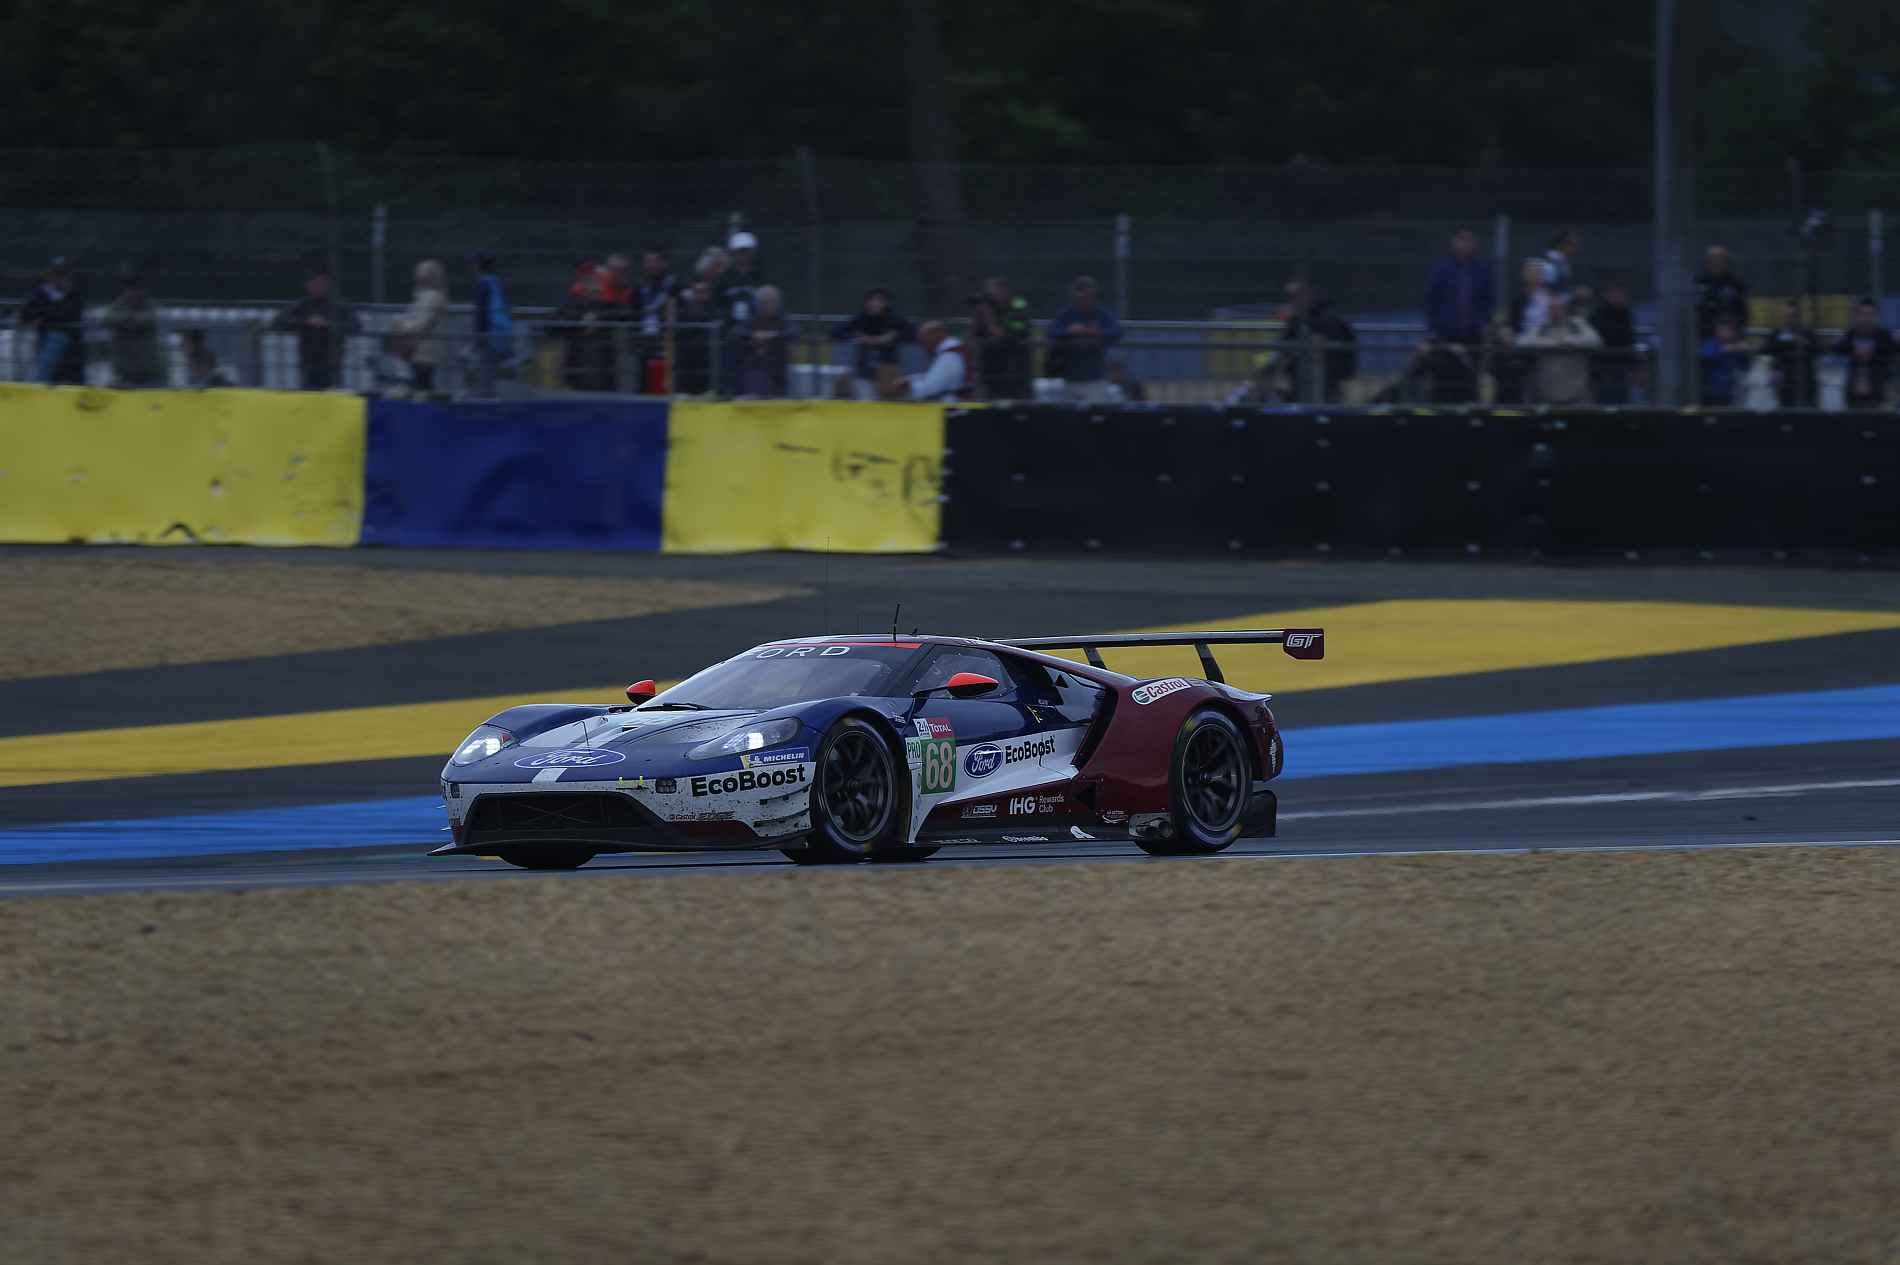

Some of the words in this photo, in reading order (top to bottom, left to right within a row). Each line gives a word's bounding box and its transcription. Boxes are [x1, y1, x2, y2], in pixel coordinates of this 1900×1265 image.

[752, 646, 850, 659] ORD
[1146, 679, 1188, 698] Castrol
[763, 752, 805, 763] MICHELIN
[907, 741, 921, 759] PRO
[1005, 736, 1056, 765] EcoBoost
[926, 742, 953, 790] 68
[690, 763, 807, 797] EcoBoost
[1009, 796, 1036, 815] IHG
[1039, 793, 1065, 803] Rewards
[1038, 803, 1055, 814] Club
